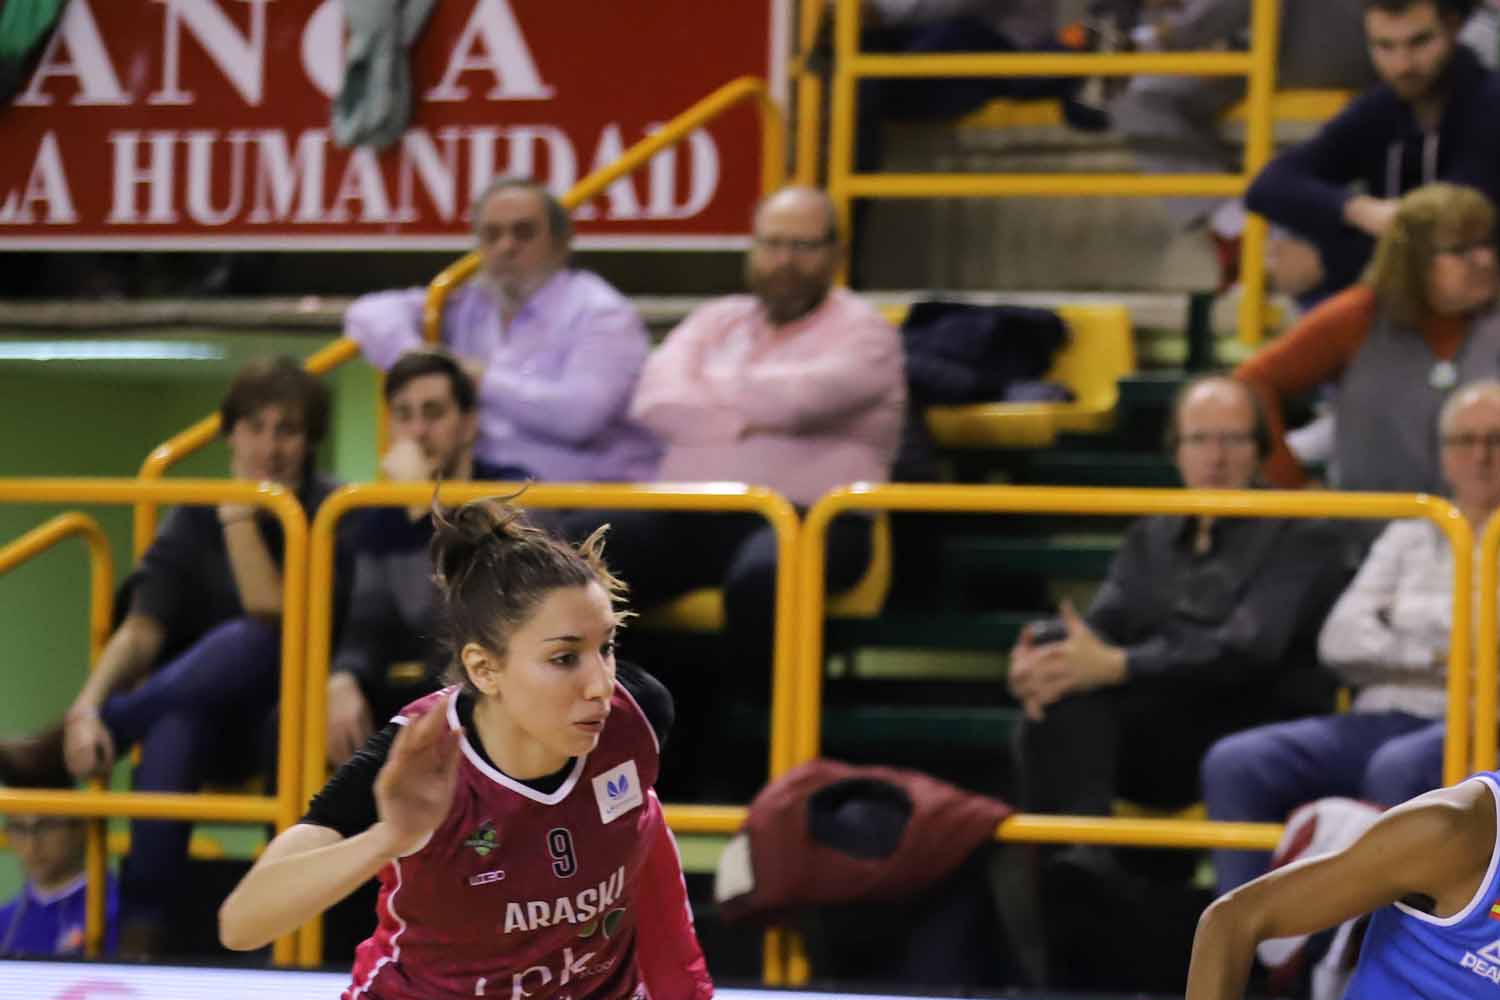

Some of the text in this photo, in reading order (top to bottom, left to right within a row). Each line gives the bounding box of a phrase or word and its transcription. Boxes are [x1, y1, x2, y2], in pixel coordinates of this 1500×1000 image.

[107, 122, 722, 226] HUMANIDAD
[547, 827, 577, 879] 9
[504, 866, 625, 934] ARASKI
